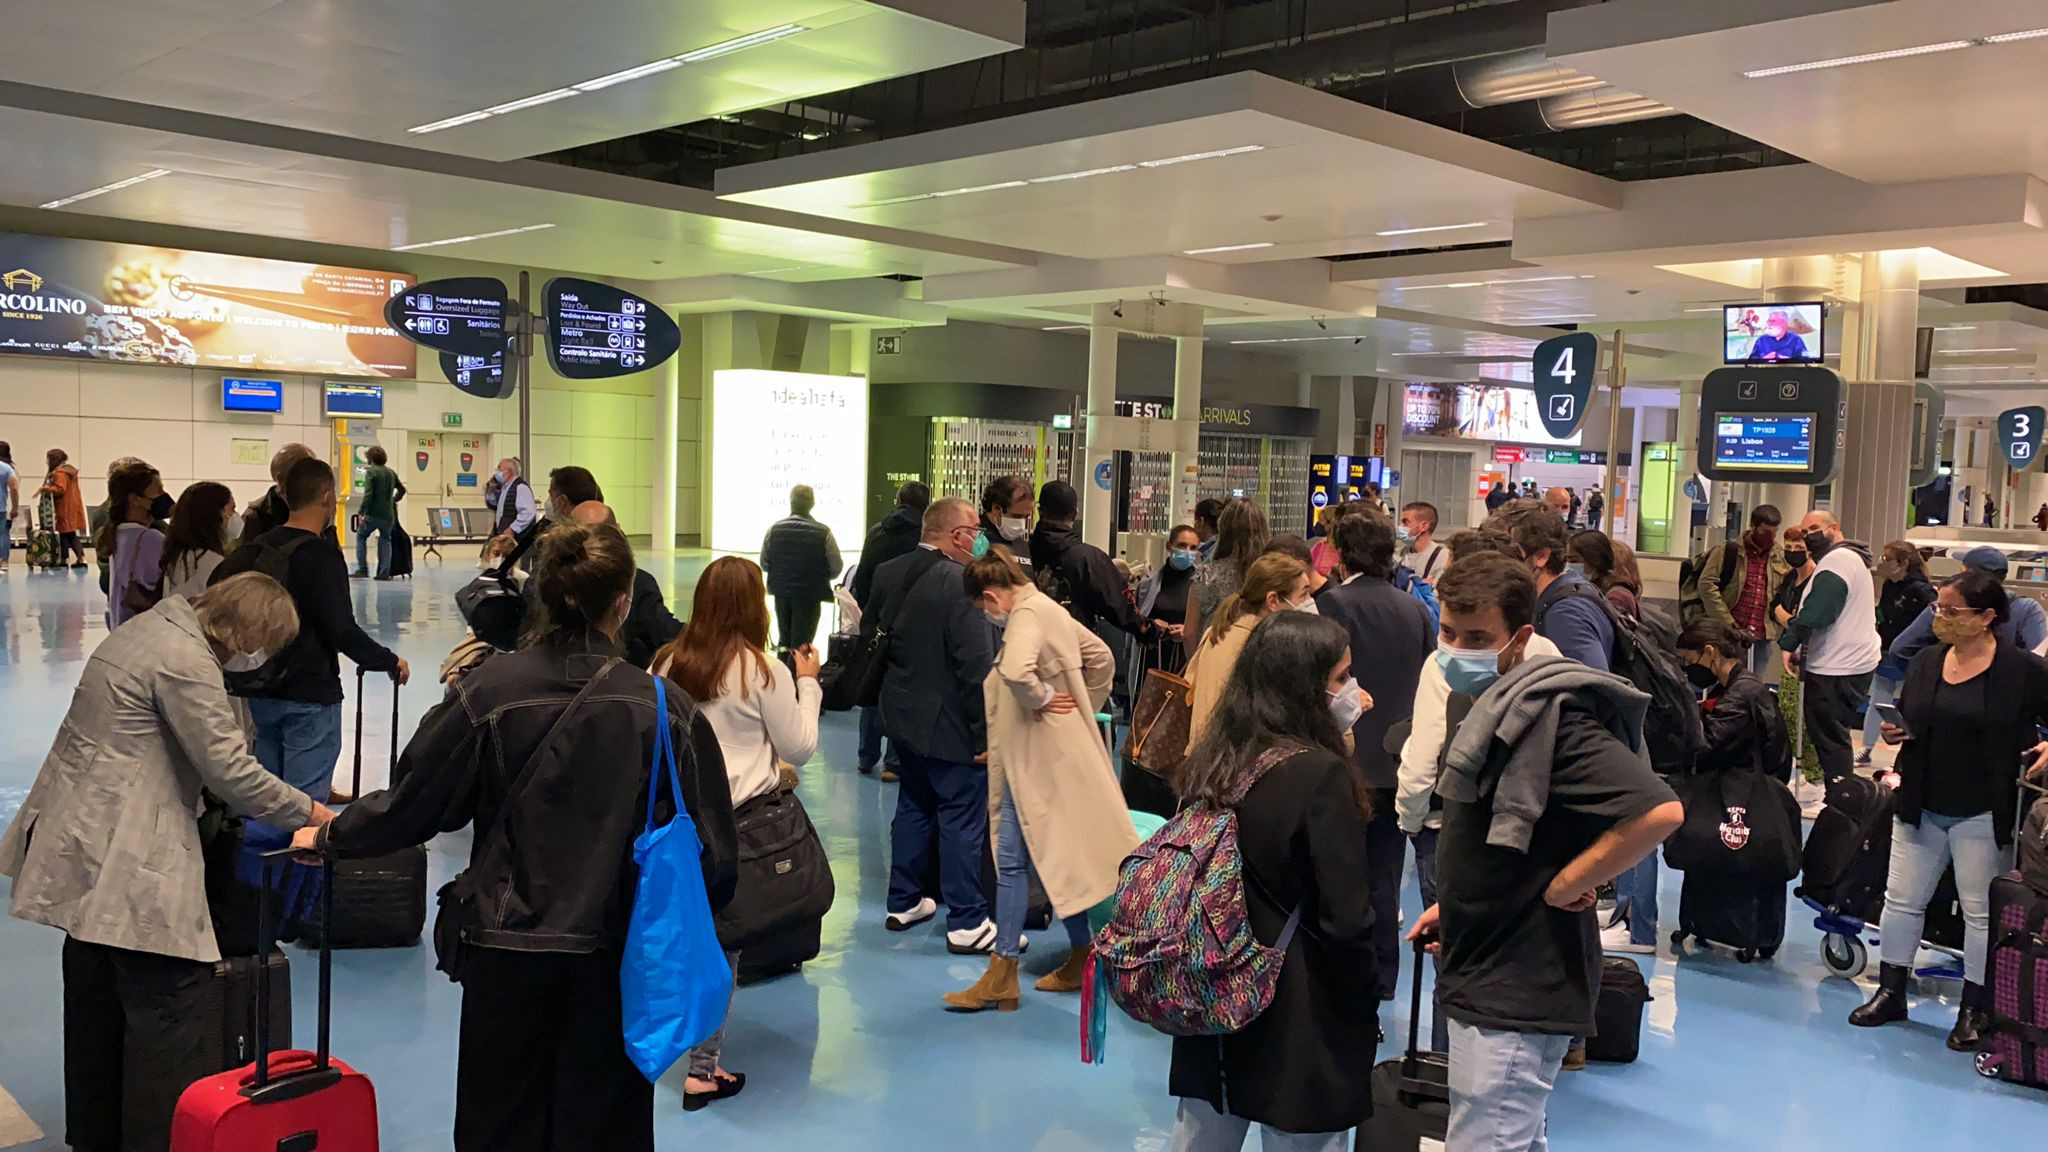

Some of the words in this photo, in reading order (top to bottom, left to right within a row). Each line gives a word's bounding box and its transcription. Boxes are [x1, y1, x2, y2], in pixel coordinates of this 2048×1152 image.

[104, 304, 129, 315] BEM
[435, 304, 470, 313] Oversized
[561, 301, 575, 310] Way
[26, 313, 44, 321] 1926
[232, 315, 284, 328] WELCOME
[284, 319, 300, 329] TO
[467, 319, 501, 329] Sanitários
[560, 320, 574, 328] Lost
[561, 329, 583, 338] Metro
[560, 348, 588, 357] Controlo
[588, 350, 617, 359] Sanitário
[560, 355, 579, 364] Public
[580, 357, 601, 365] Health
[1551, 347, 1577, 385] 4
[1406, 404, 1417, 414] UP
[1417, 404, 1427, 415] TO
[1406, 413, 1440, 425] DISCOUNT
[2012, 413, 2030, 438] 3
[887, 472, 899, 481] THE
